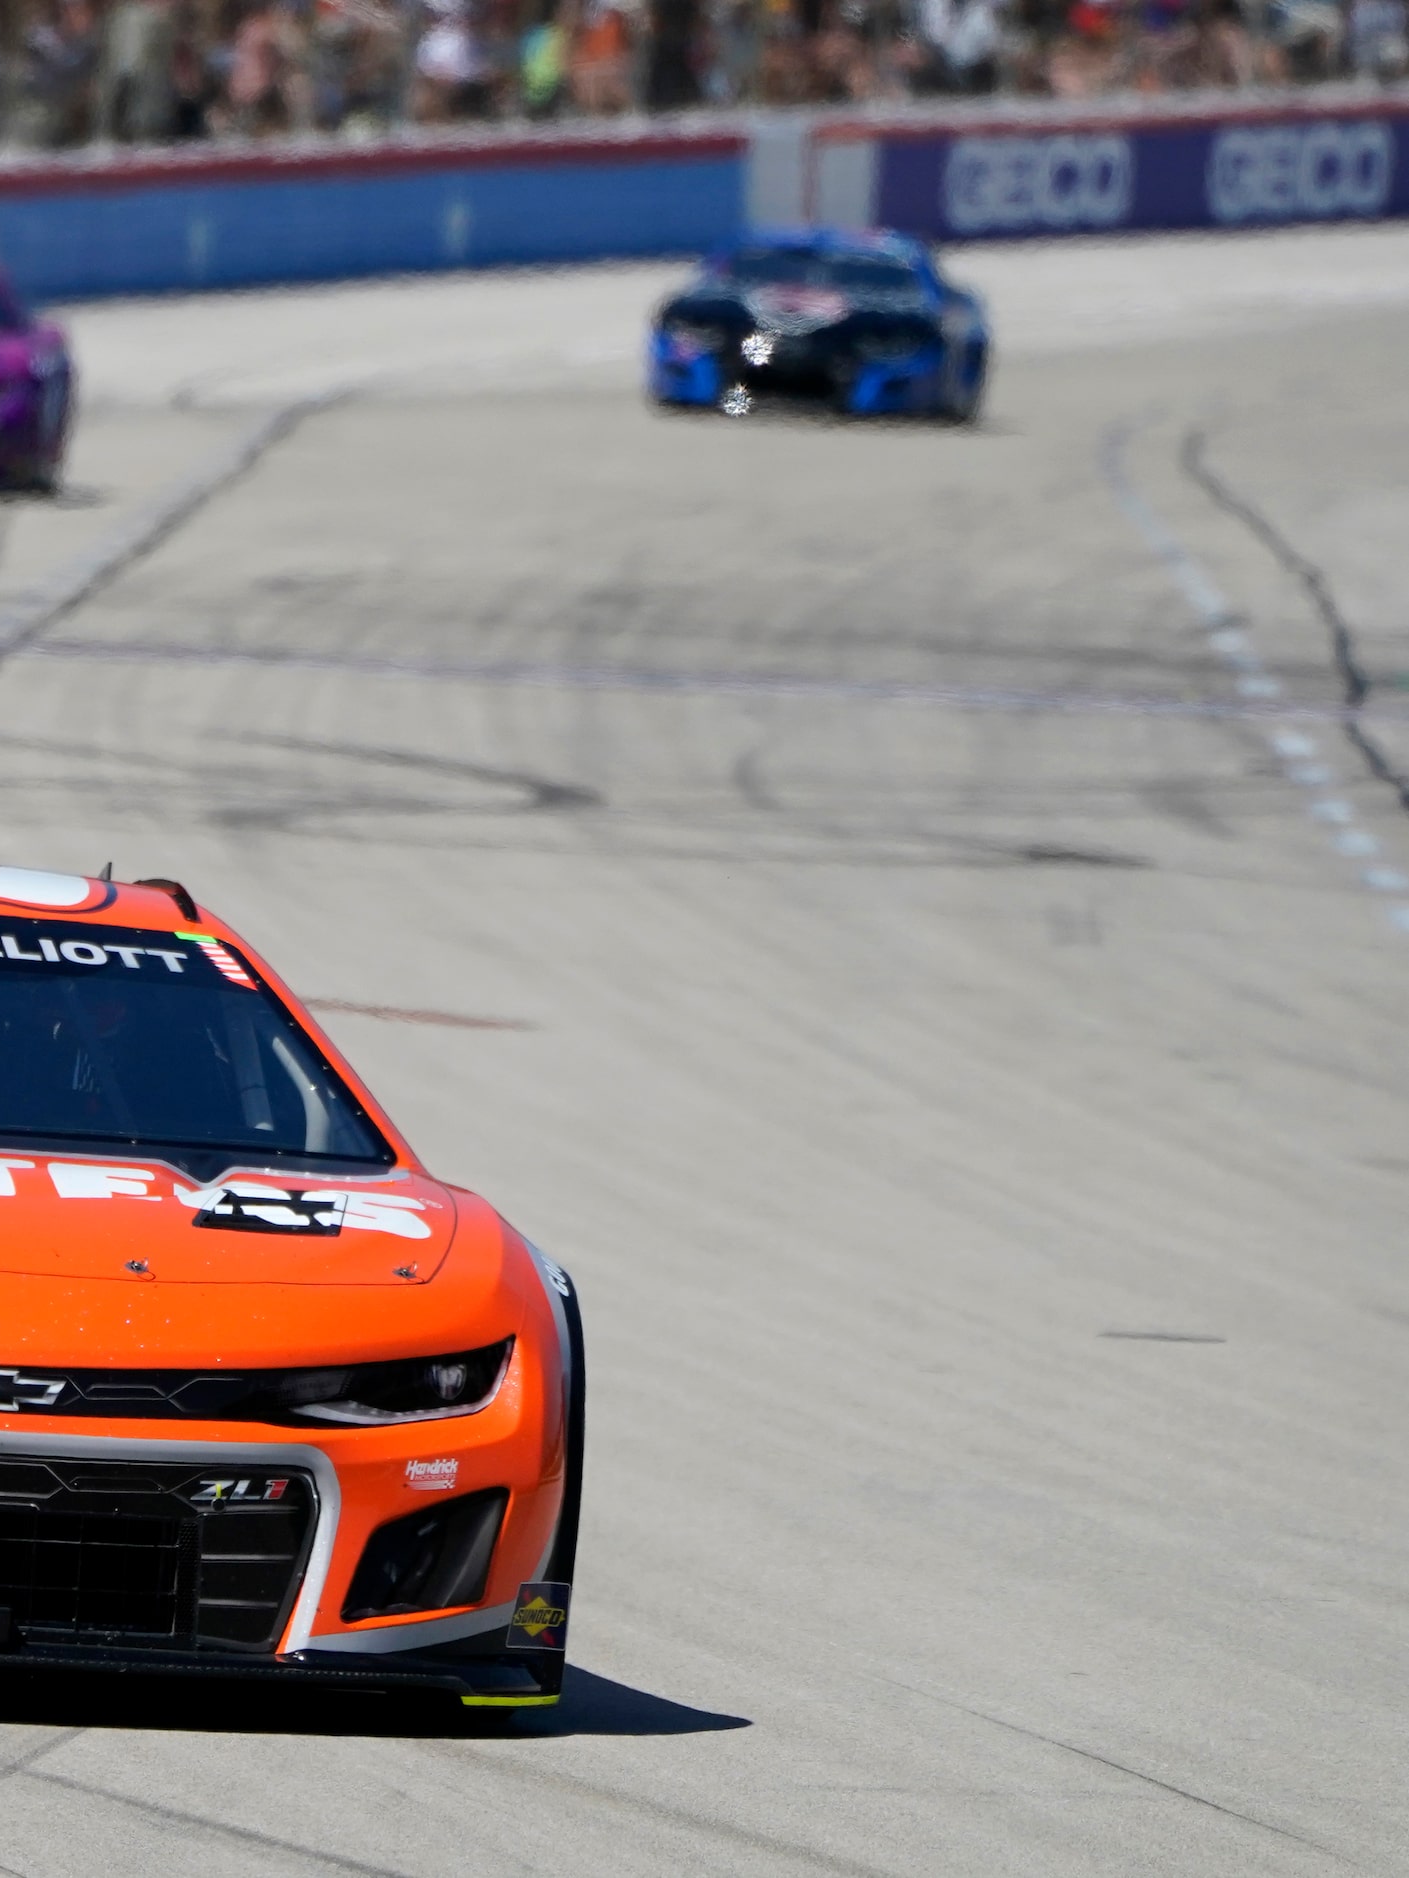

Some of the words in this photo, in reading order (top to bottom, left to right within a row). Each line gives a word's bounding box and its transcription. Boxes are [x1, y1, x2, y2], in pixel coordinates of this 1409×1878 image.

[405, 1458, 460, 1481] Hendrick
[190, 1478, 290, 1501] ZL1
[514, 1608, 562, 1626] SUNOCO
